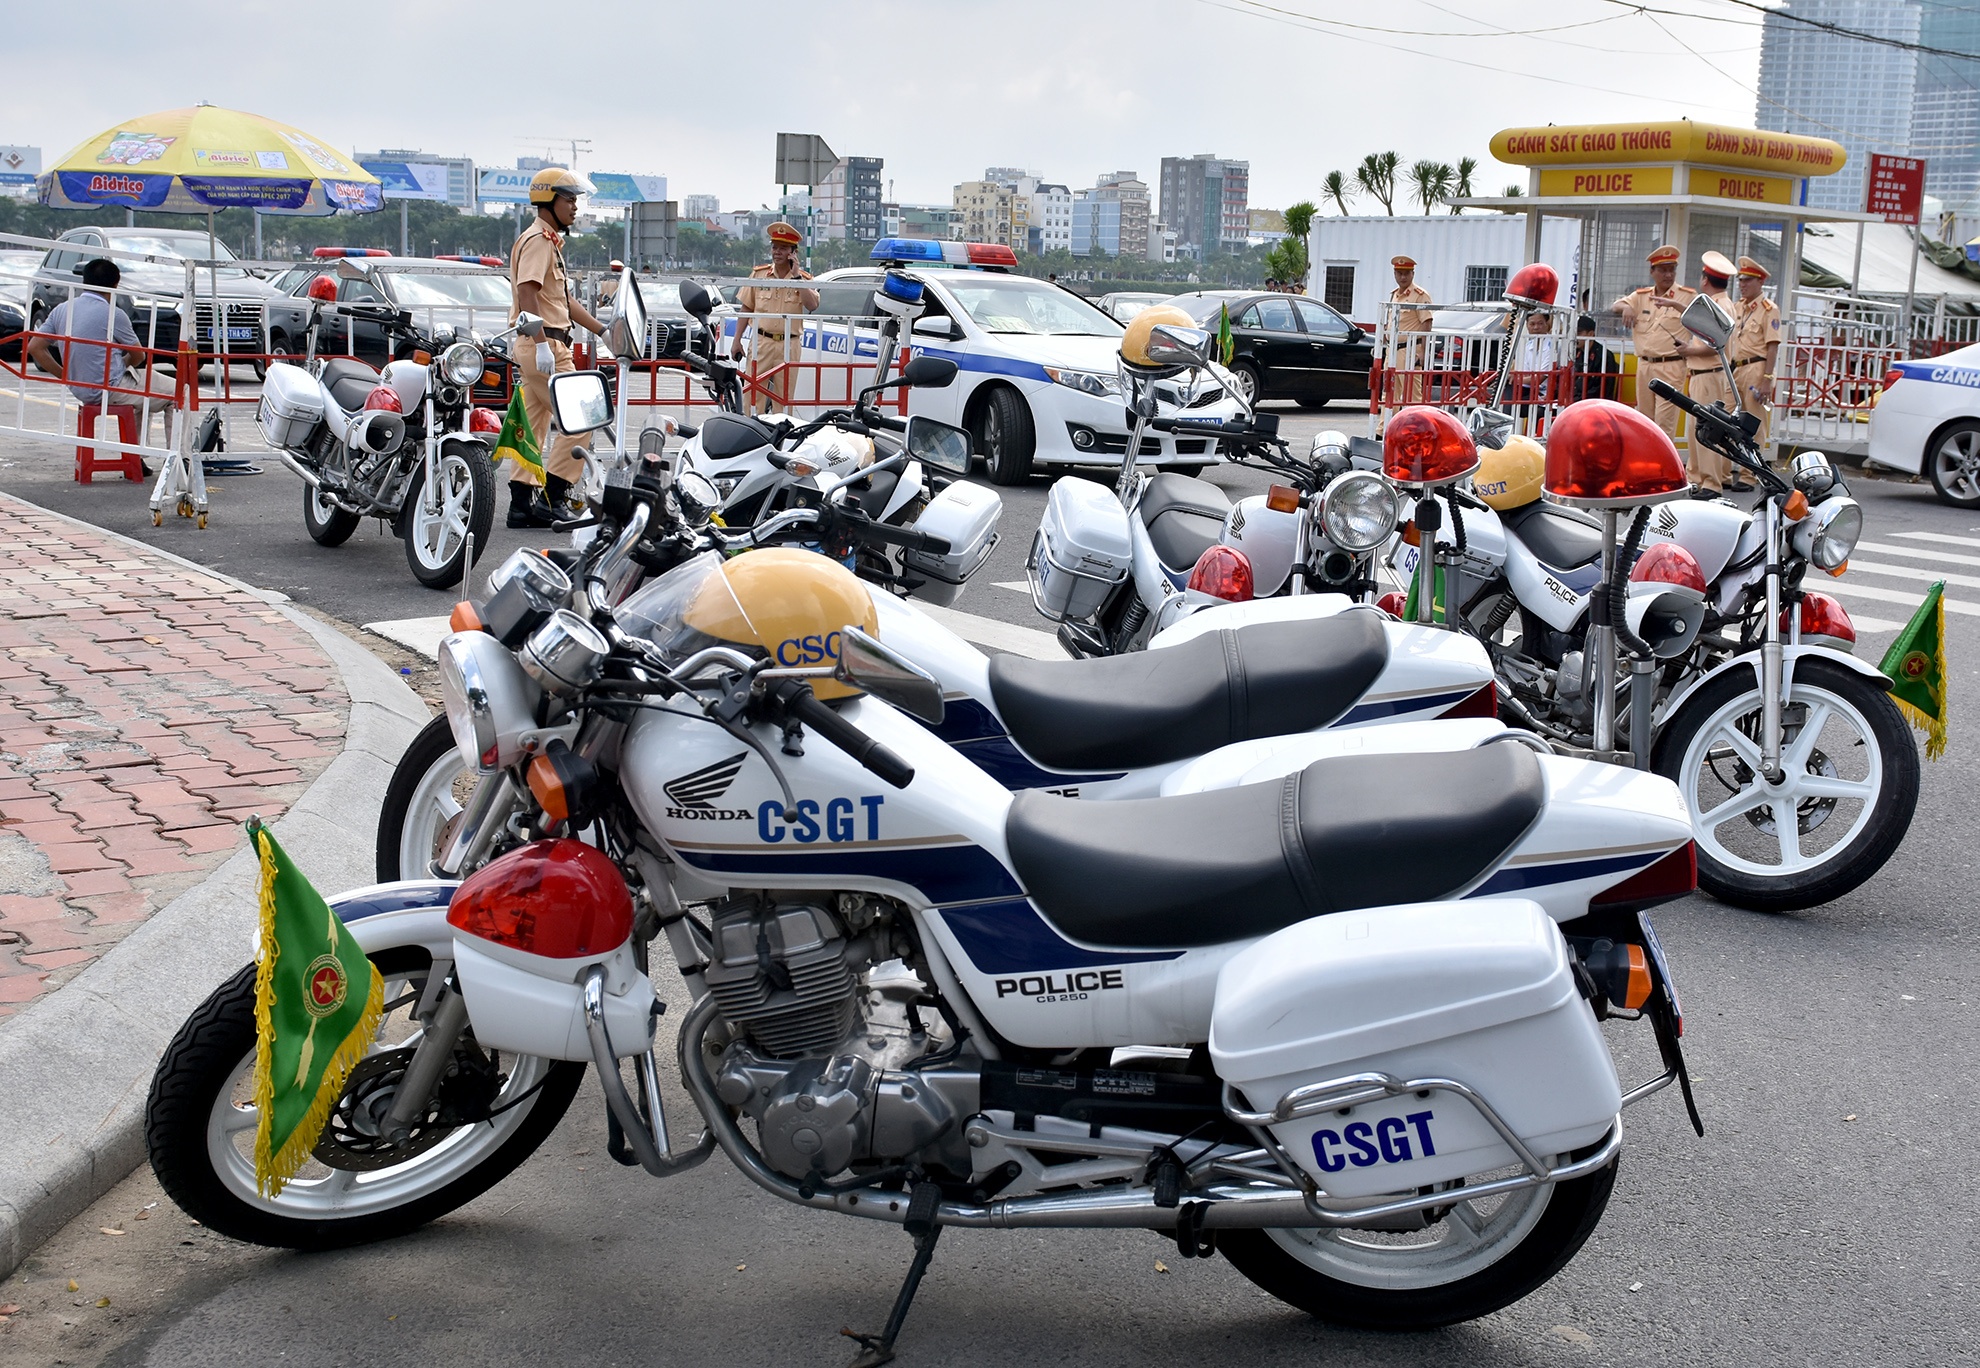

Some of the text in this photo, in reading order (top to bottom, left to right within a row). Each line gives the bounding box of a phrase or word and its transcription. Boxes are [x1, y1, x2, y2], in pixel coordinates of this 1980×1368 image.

[1550, 132, 1578, 152] SÁT
[1582, 133, 1616, 152] GIAO
[1621, 128, 1672, 150] THÔNG
[210, 154, 249, 163] Bidrico
[1766, 140, 1794, 161] GIAO
[1796, 142, 1834, 166] THÔNG
[91, 175, 144, 193] Bidrico
[336, 183, 365, 199] Bidrico
[1574, 174, 1633, 192] POLICE
[1719, 178, 1765, 199] POLICE
[827, 336, 856, 354] GIA
[828, 456, 850, 467] HONDA
[1650, 526, 1675, 539] HONDA
[1544, 577, 1578, 606] POLICE
[666, 807, 754, 820] HONDA
[757, 795, 884, 843] CSGT
[995, 969, 1124, 998] POLICE
[1036, 993, 1088, 1003] CB 250
[1311, 1110, 1436, 1173] CSGT
